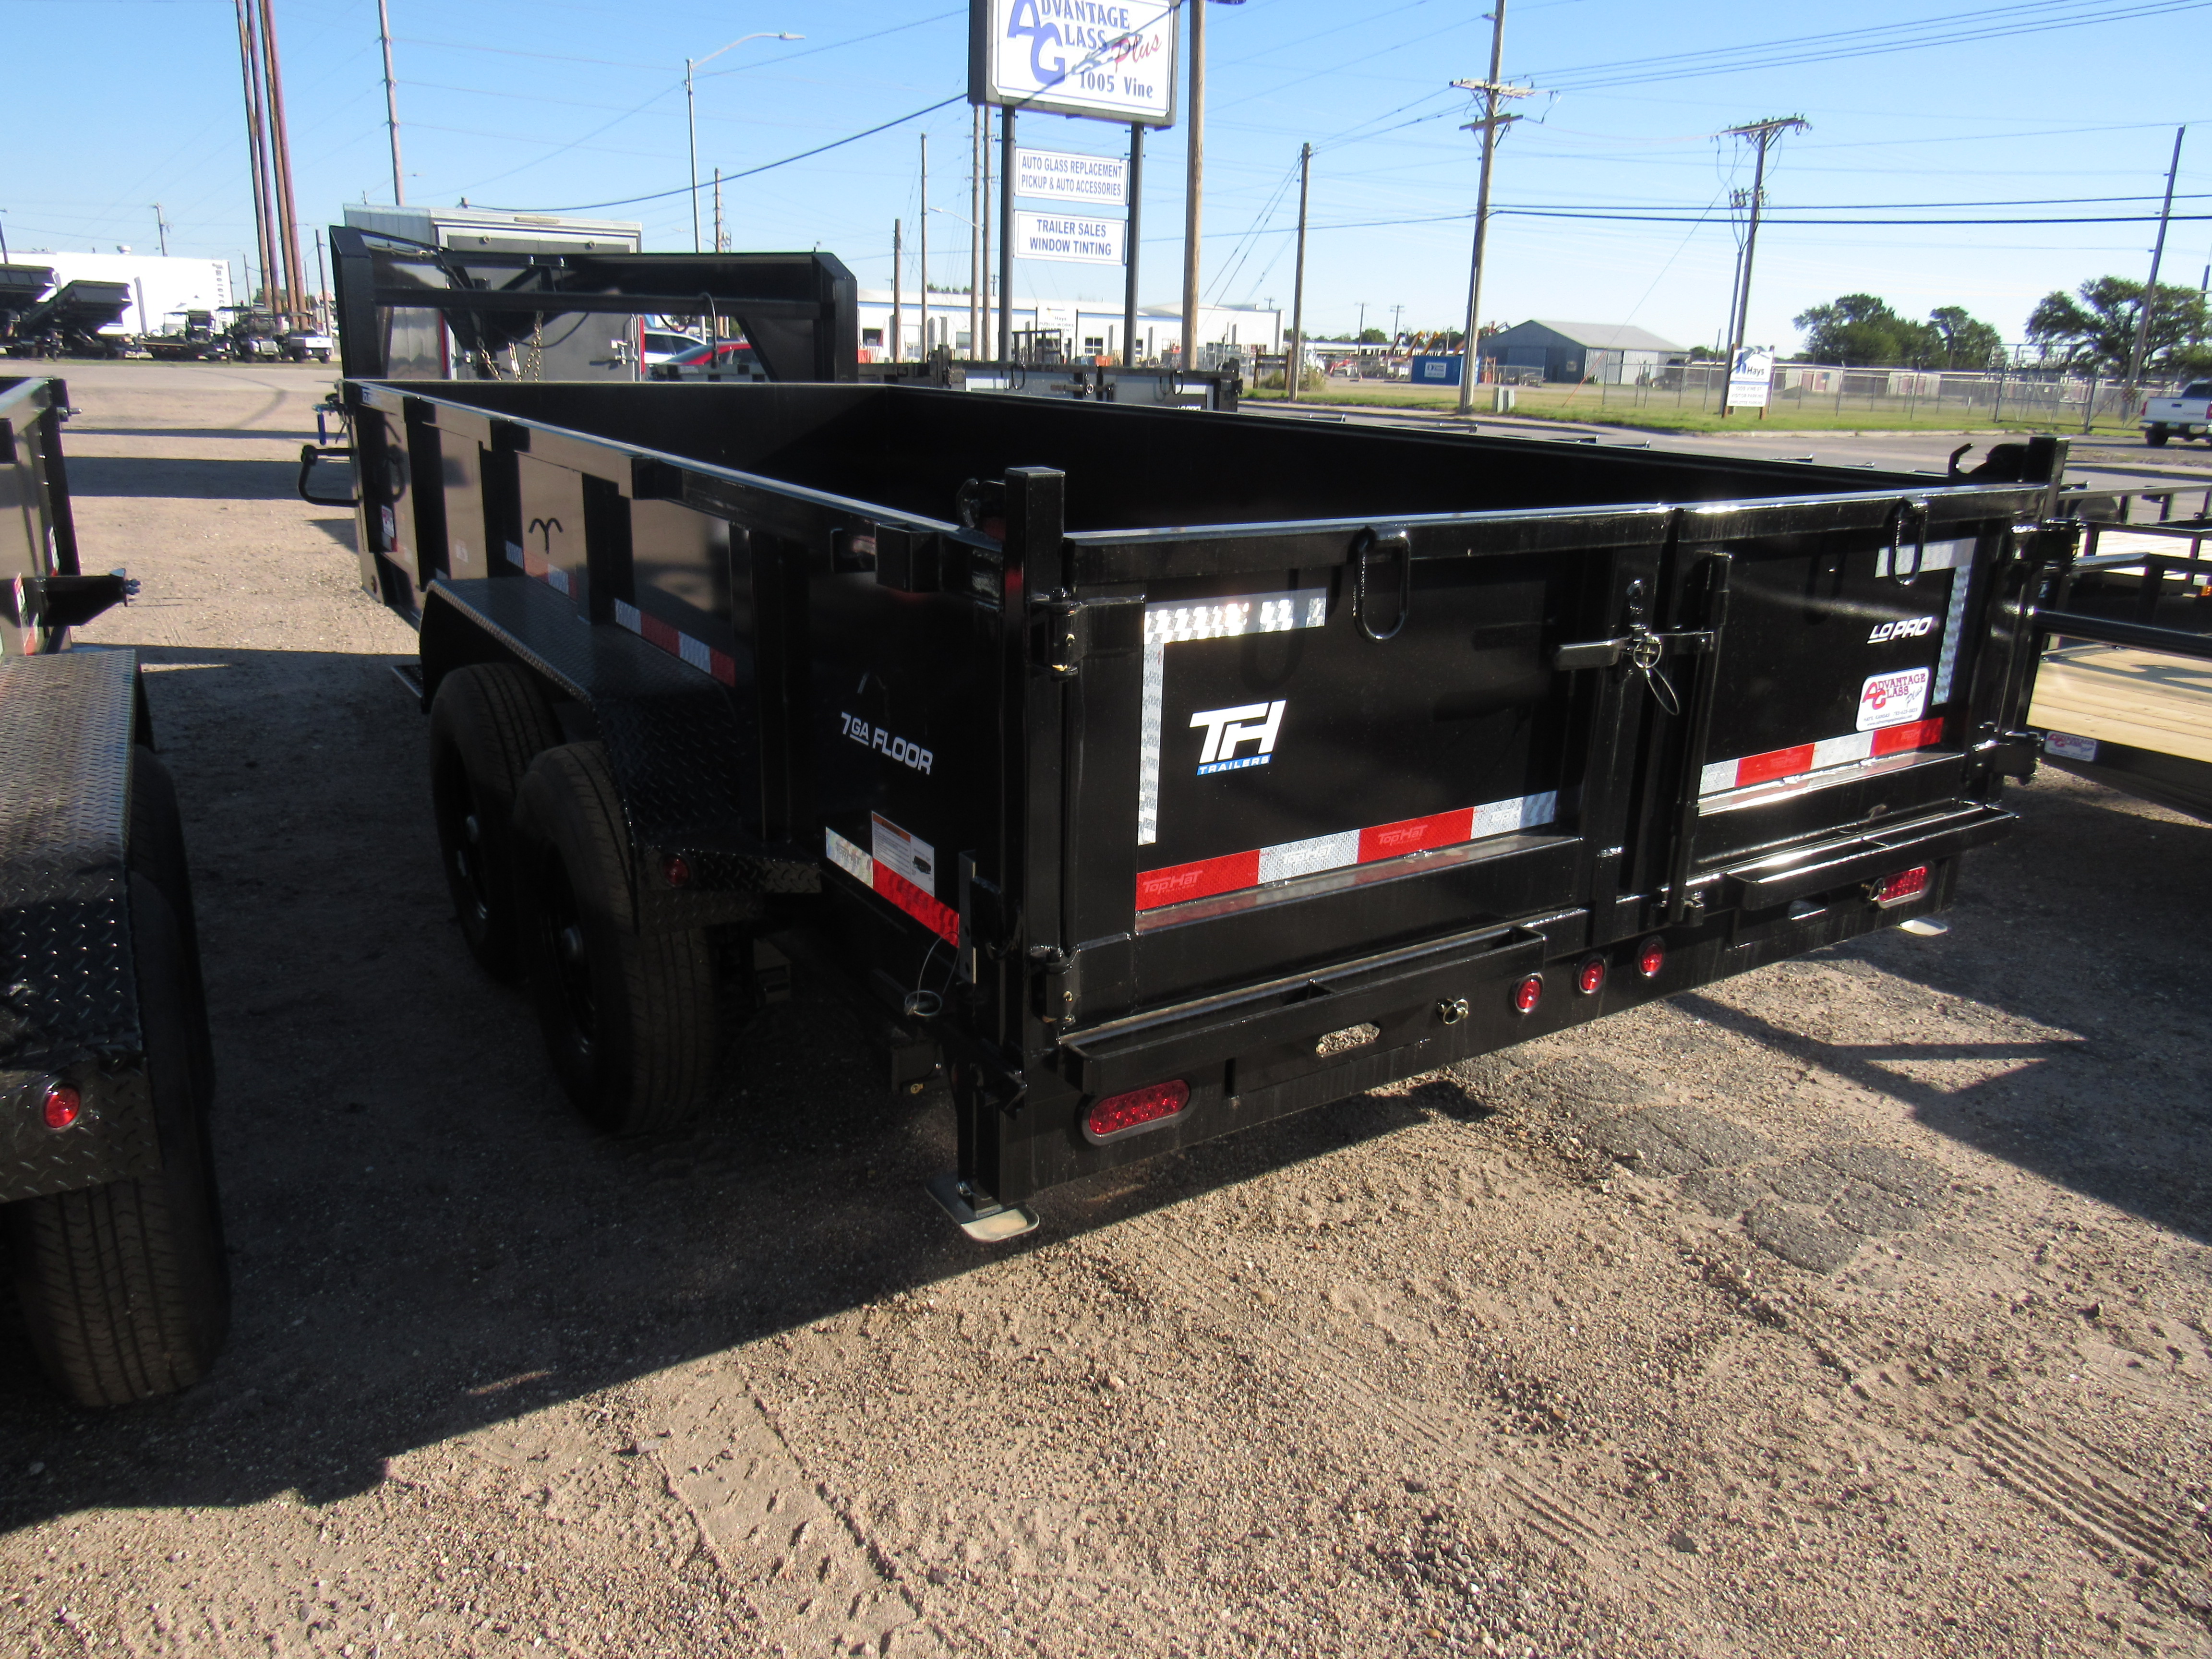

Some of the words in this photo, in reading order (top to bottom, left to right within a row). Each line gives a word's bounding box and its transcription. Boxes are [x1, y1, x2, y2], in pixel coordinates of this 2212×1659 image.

[1080, 72, 1115, 93] 1005
[1124, 76, 1153, 99] Vine
[1022, 156, 1042, 170] AUTO
[1045, 158, 1068, 173] GLASS
[1070, 160, 1122, 179] REPLACEMENT
[1022, 174, 1047, 190] PICKUP
[1049, 179, 1054, 190] &
[1056, 178, 1074, 192] AUTO
[1076, 180, 1121, 196] ACCESSORIES
[1037, 219, 1075, 235] TRAILER
[1078, 223, 1106, 238] SALES
[1030, 237, 1070, 252] WINDOW
[1073, 241, 1111, 256] TINTING
[1747, 366, 1765, 376] Hays
[1862, 673, 1926, 703] ADVANTAGE
[1872, 686, 1909, 710] GLASS
[1189, 699, 1286, 764] TH
[872, 727, 933, 776] FLOOR
[1199, 756, 1270, 775] TRAILERS
